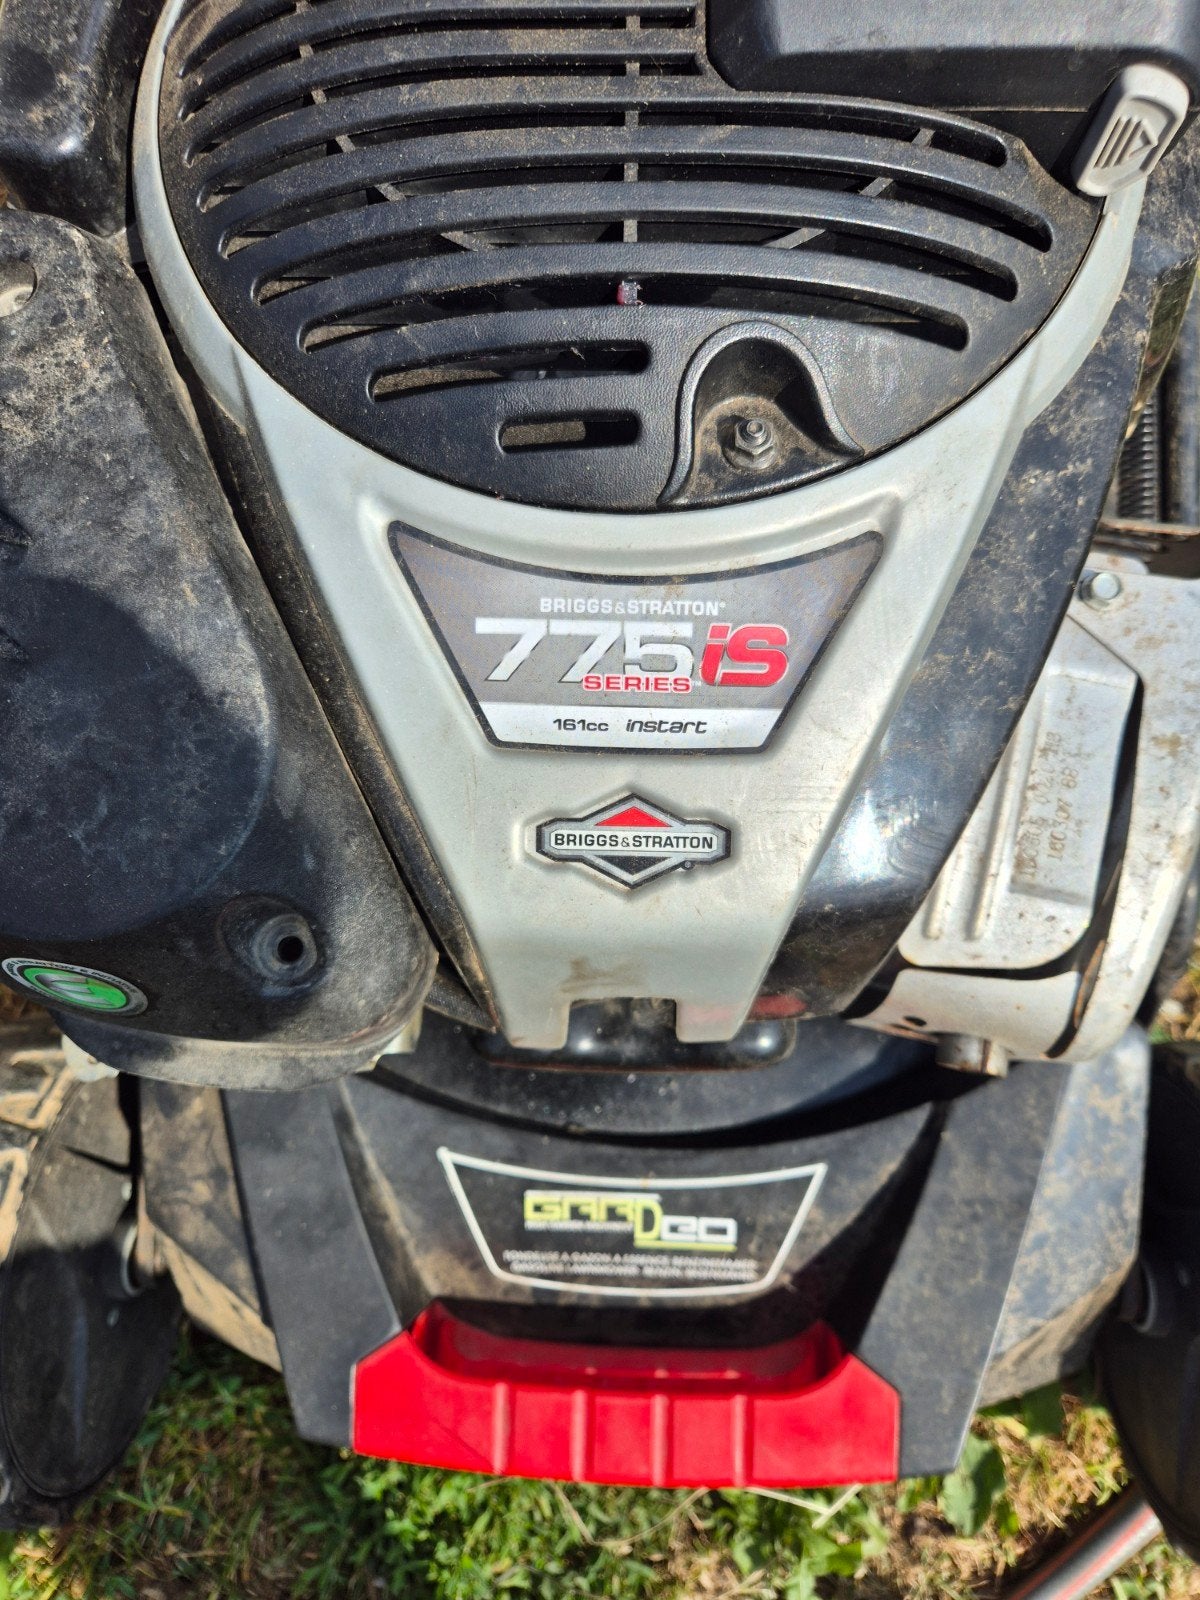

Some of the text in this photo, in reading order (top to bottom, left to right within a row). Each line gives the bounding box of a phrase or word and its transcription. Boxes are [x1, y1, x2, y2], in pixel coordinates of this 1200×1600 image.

[583, 674, 692, 693] SERIES
[552, 718, 708, 734] 161cc instart
